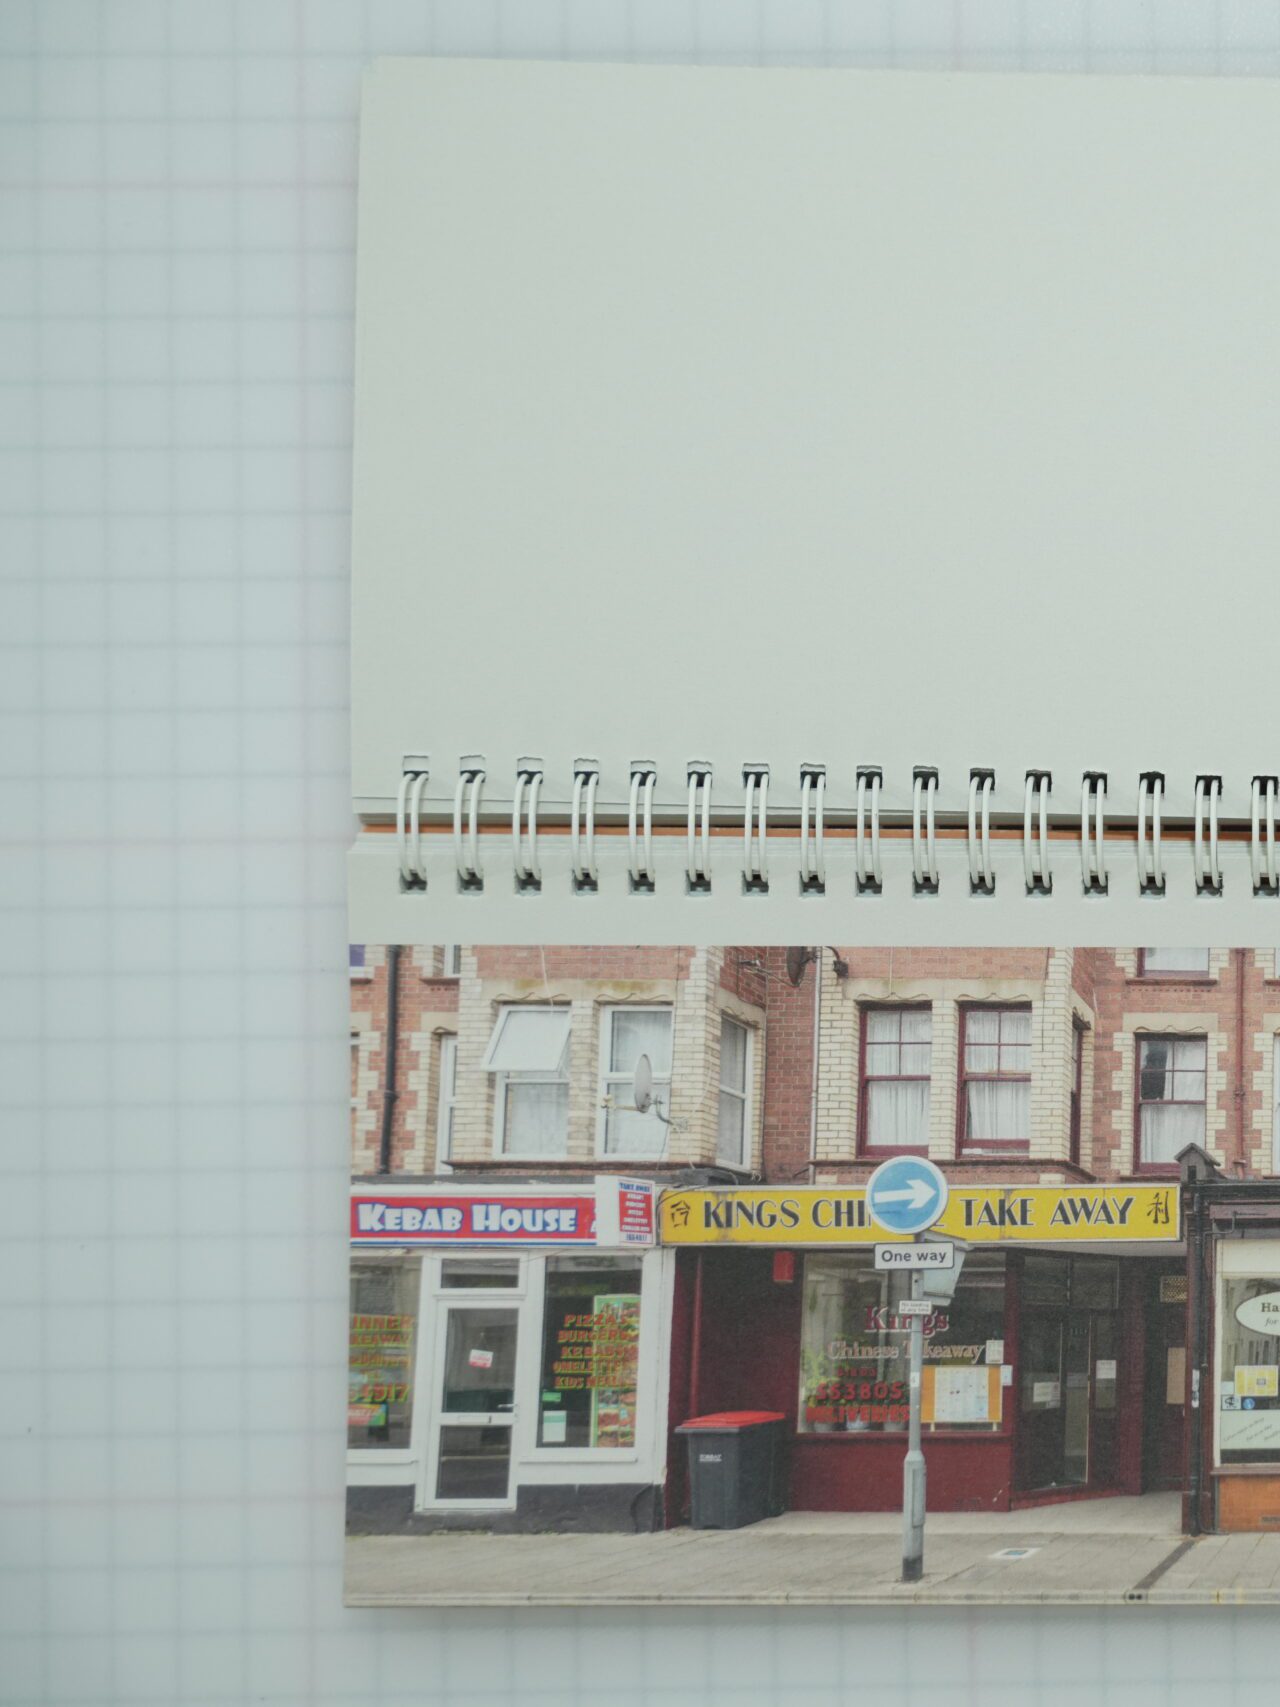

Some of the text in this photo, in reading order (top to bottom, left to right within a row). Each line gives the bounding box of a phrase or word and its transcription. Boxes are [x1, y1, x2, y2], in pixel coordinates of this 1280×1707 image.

[357, 1202, 464, 1232] KEBAB
[471, 1204, 577, 1233] HOUSE
[704, 1199, 801, 1228] KINGS
[959, 1198, 1034, 1226] TAKE
[1050, 1197, 1134, 1226] AWAY
[881, 1250, 947, 1263] One way
[1265, 1317, 1278, 1327] for
[827, 1339, 986, 1364] Chinese Tkeaway
